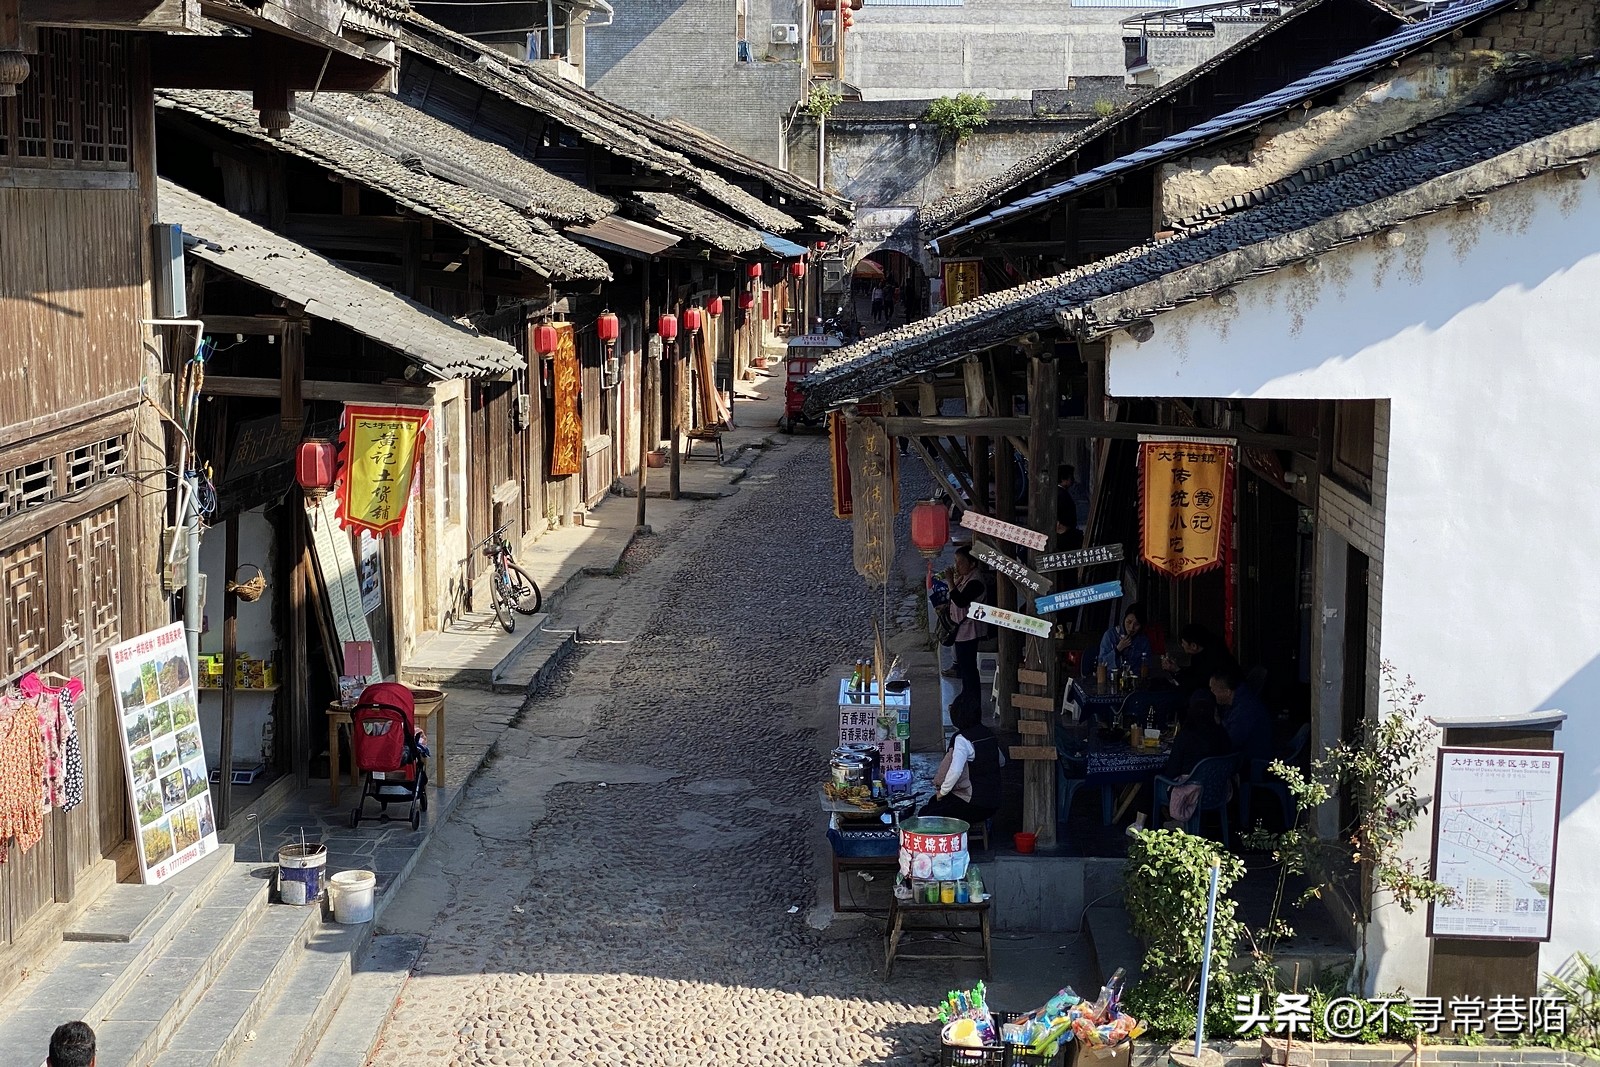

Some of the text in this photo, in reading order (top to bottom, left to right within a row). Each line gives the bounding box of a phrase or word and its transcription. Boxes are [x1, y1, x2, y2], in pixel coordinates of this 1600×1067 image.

[1169, 467, 1192, 553] 传统小吃
[1192, 490, 1214, 532] 黄记
[978, 553, 1040, 592] 也就错过了风景
[841, 711, 876, 726] 百香果汁
[841, 728, 876, 741] 百香果凉粉
